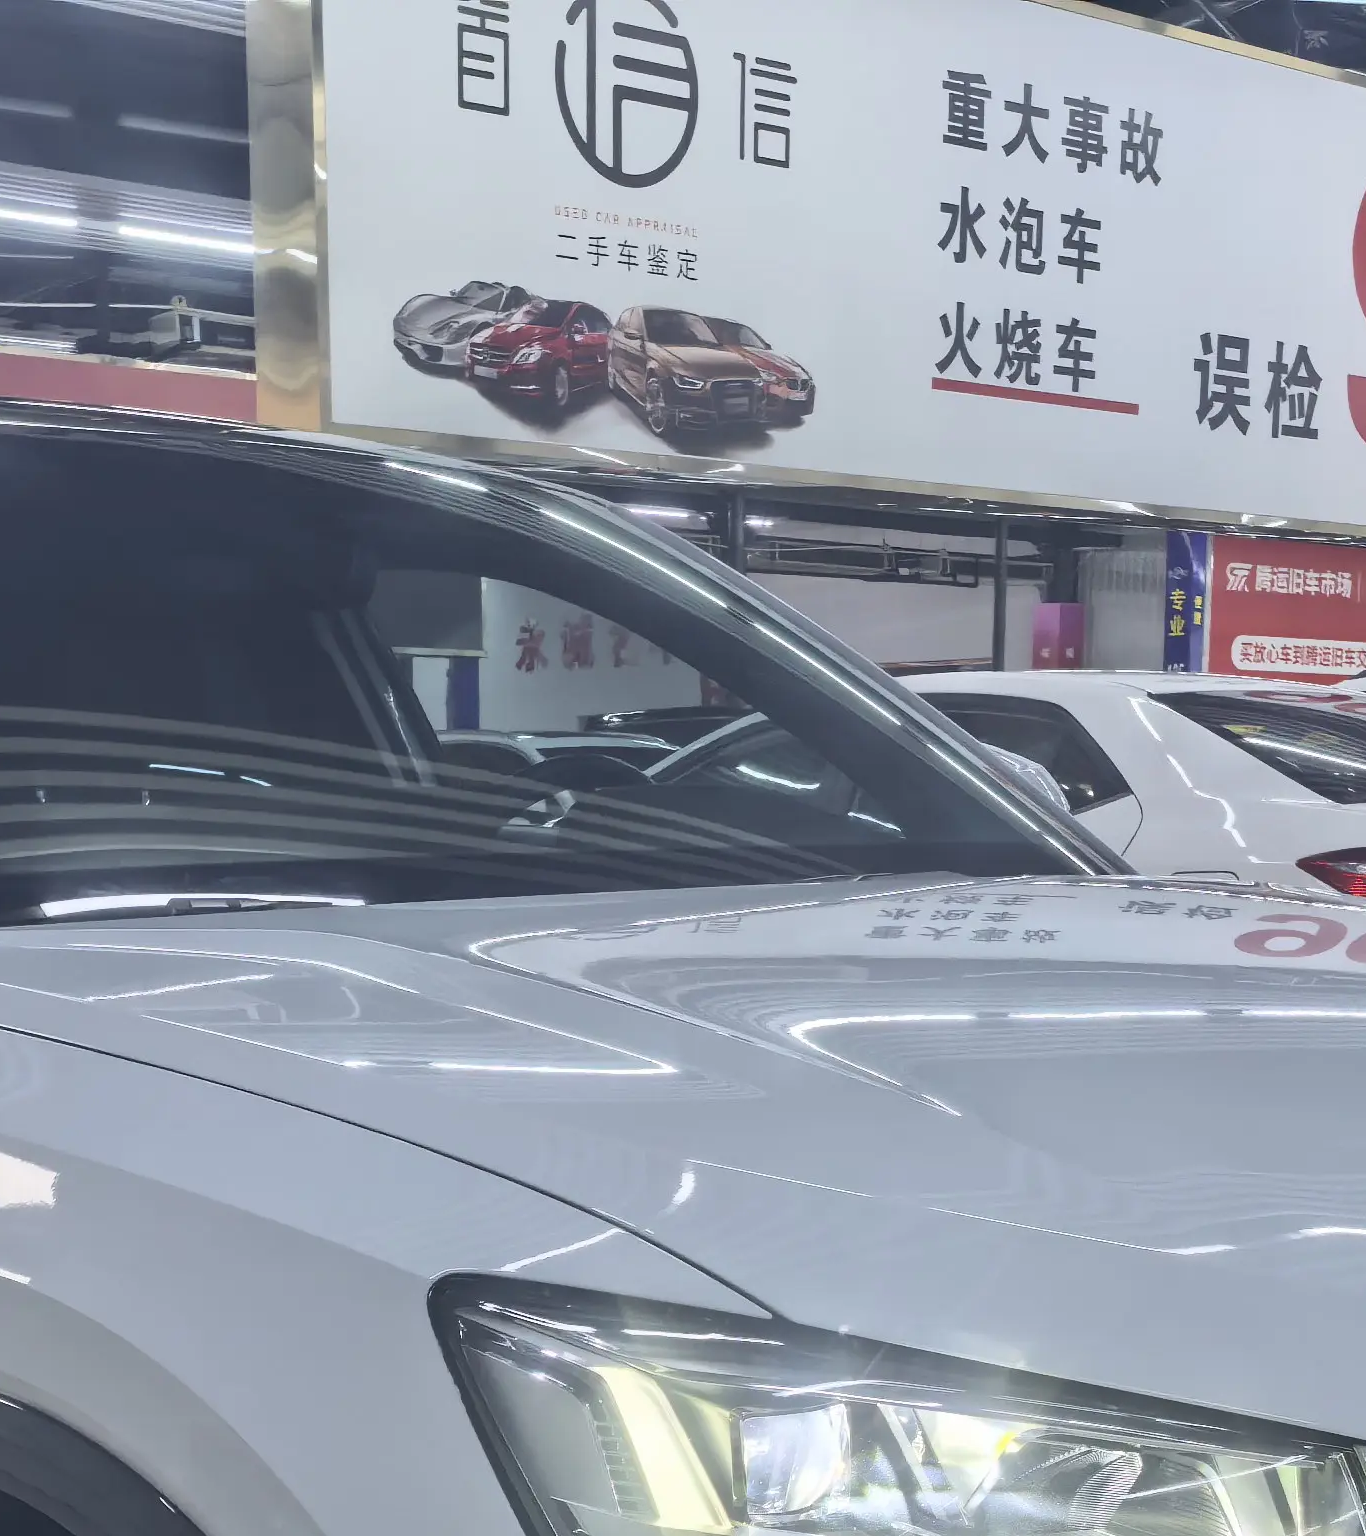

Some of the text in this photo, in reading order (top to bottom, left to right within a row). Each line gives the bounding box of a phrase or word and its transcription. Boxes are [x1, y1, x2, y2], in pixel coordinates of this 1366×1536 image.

[733, 52, 798, 168] 信
[941, 69, 1163, 186] 重大事故
[555, 234, 698, 281] 二手车鉴定
[938, 186, 1103, 284] 水泡车
[935, 301, 1097, 393] 火烧车
[1192, 332, 1323, 441] 误检
[1168, 588, 1186, 637] 专业
[1255, 564, 1353, 598] 腾运旧车市场
